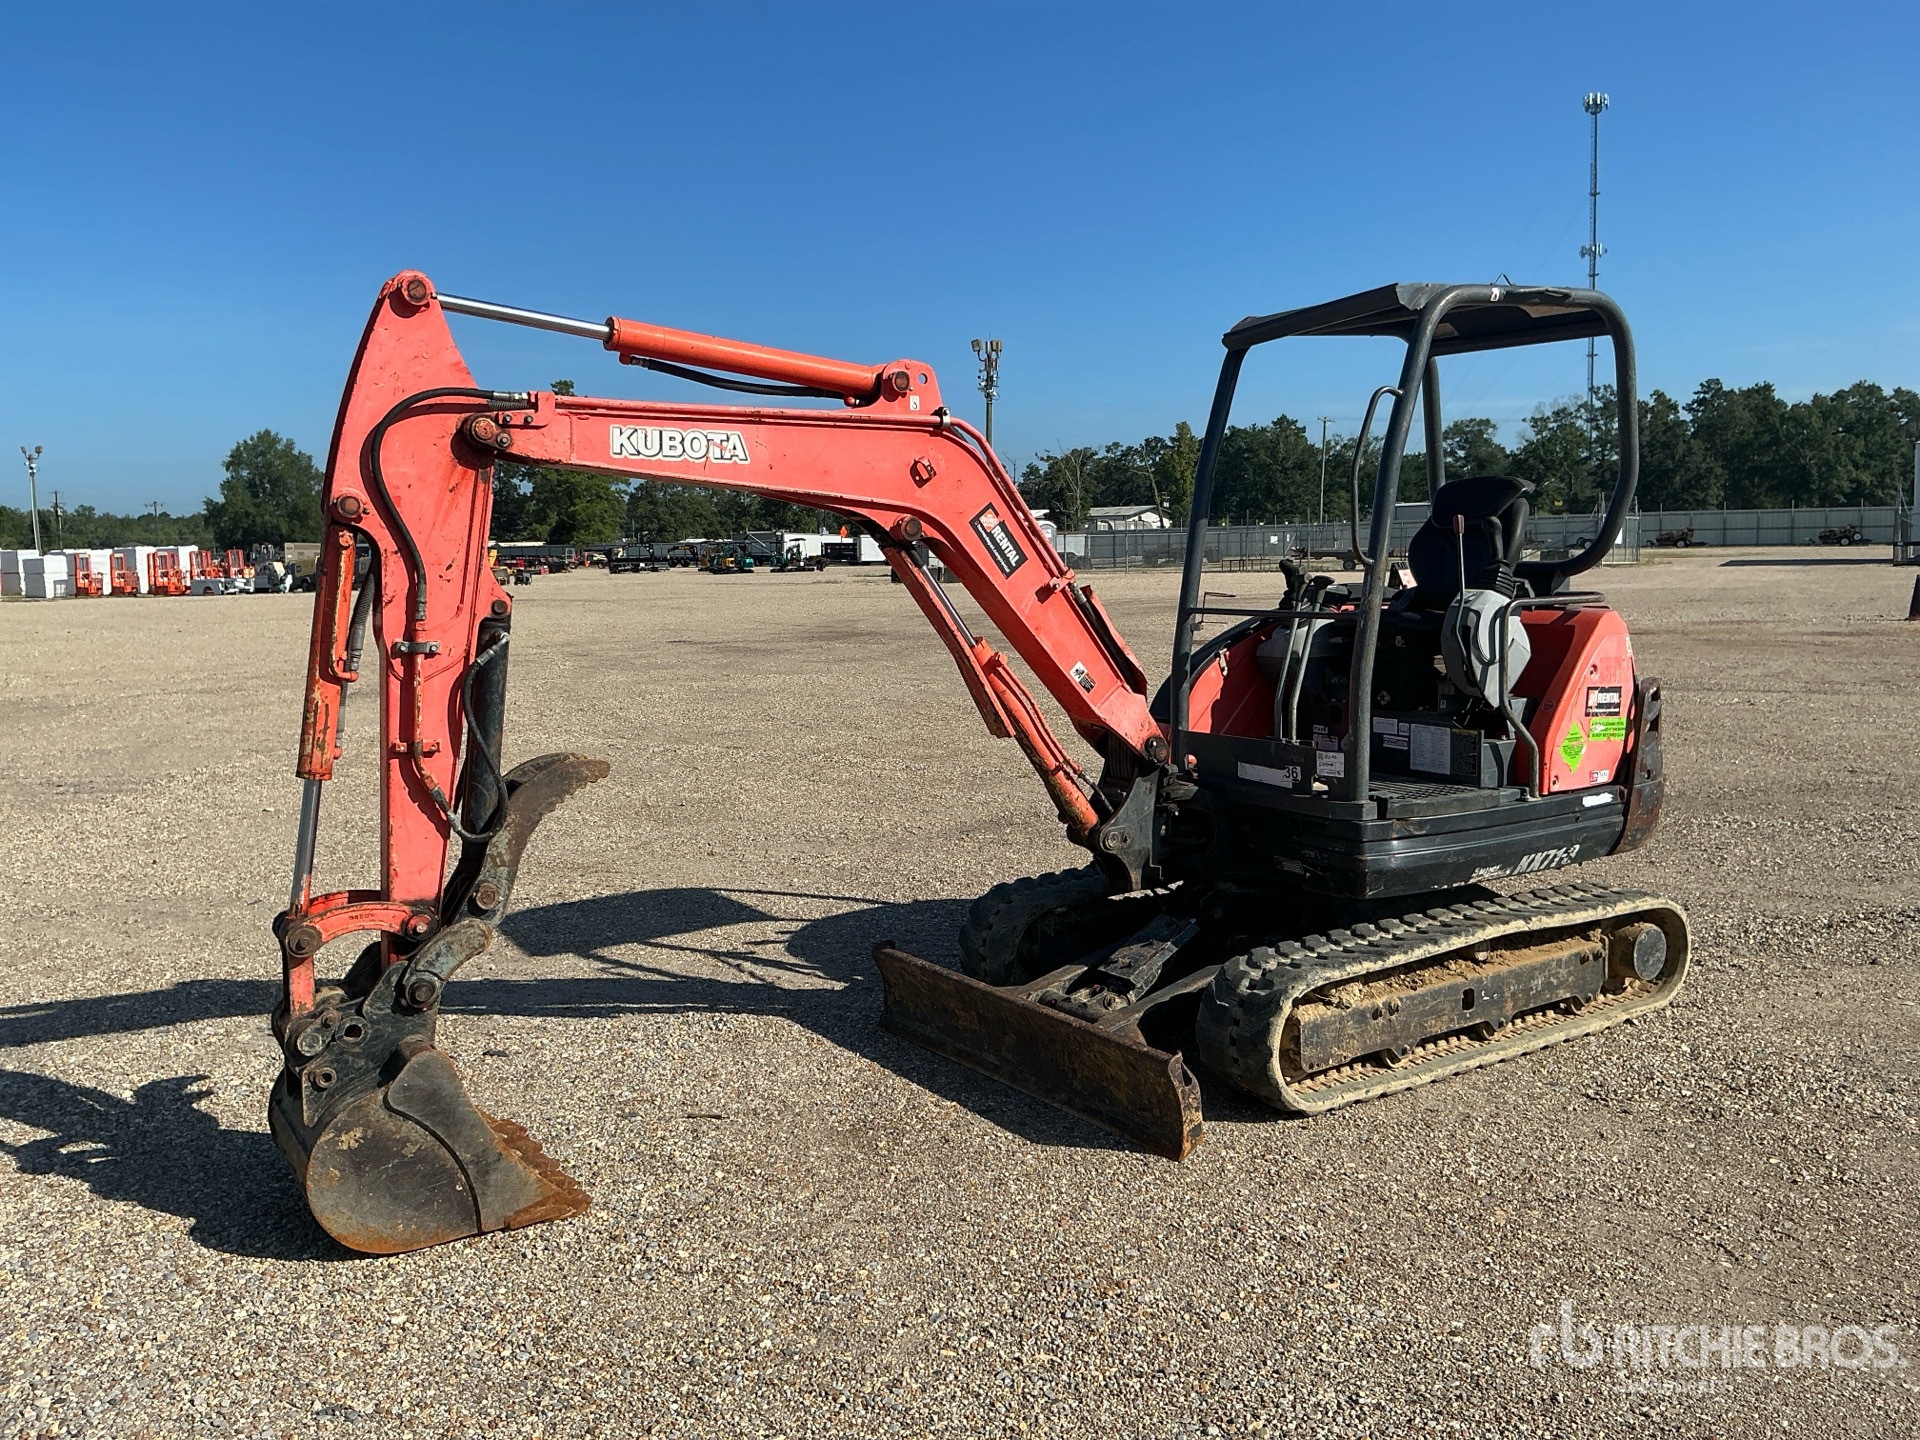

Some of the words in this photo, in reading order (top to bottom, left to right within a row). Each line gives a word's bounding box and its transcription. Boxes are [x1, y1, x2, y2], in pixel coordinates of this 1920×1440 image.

[611, 426, 750, 463] KUBOTA
[991, 526, 1019, 566] RENTAL
[1597, 692, 1620, 704] RENTAL
